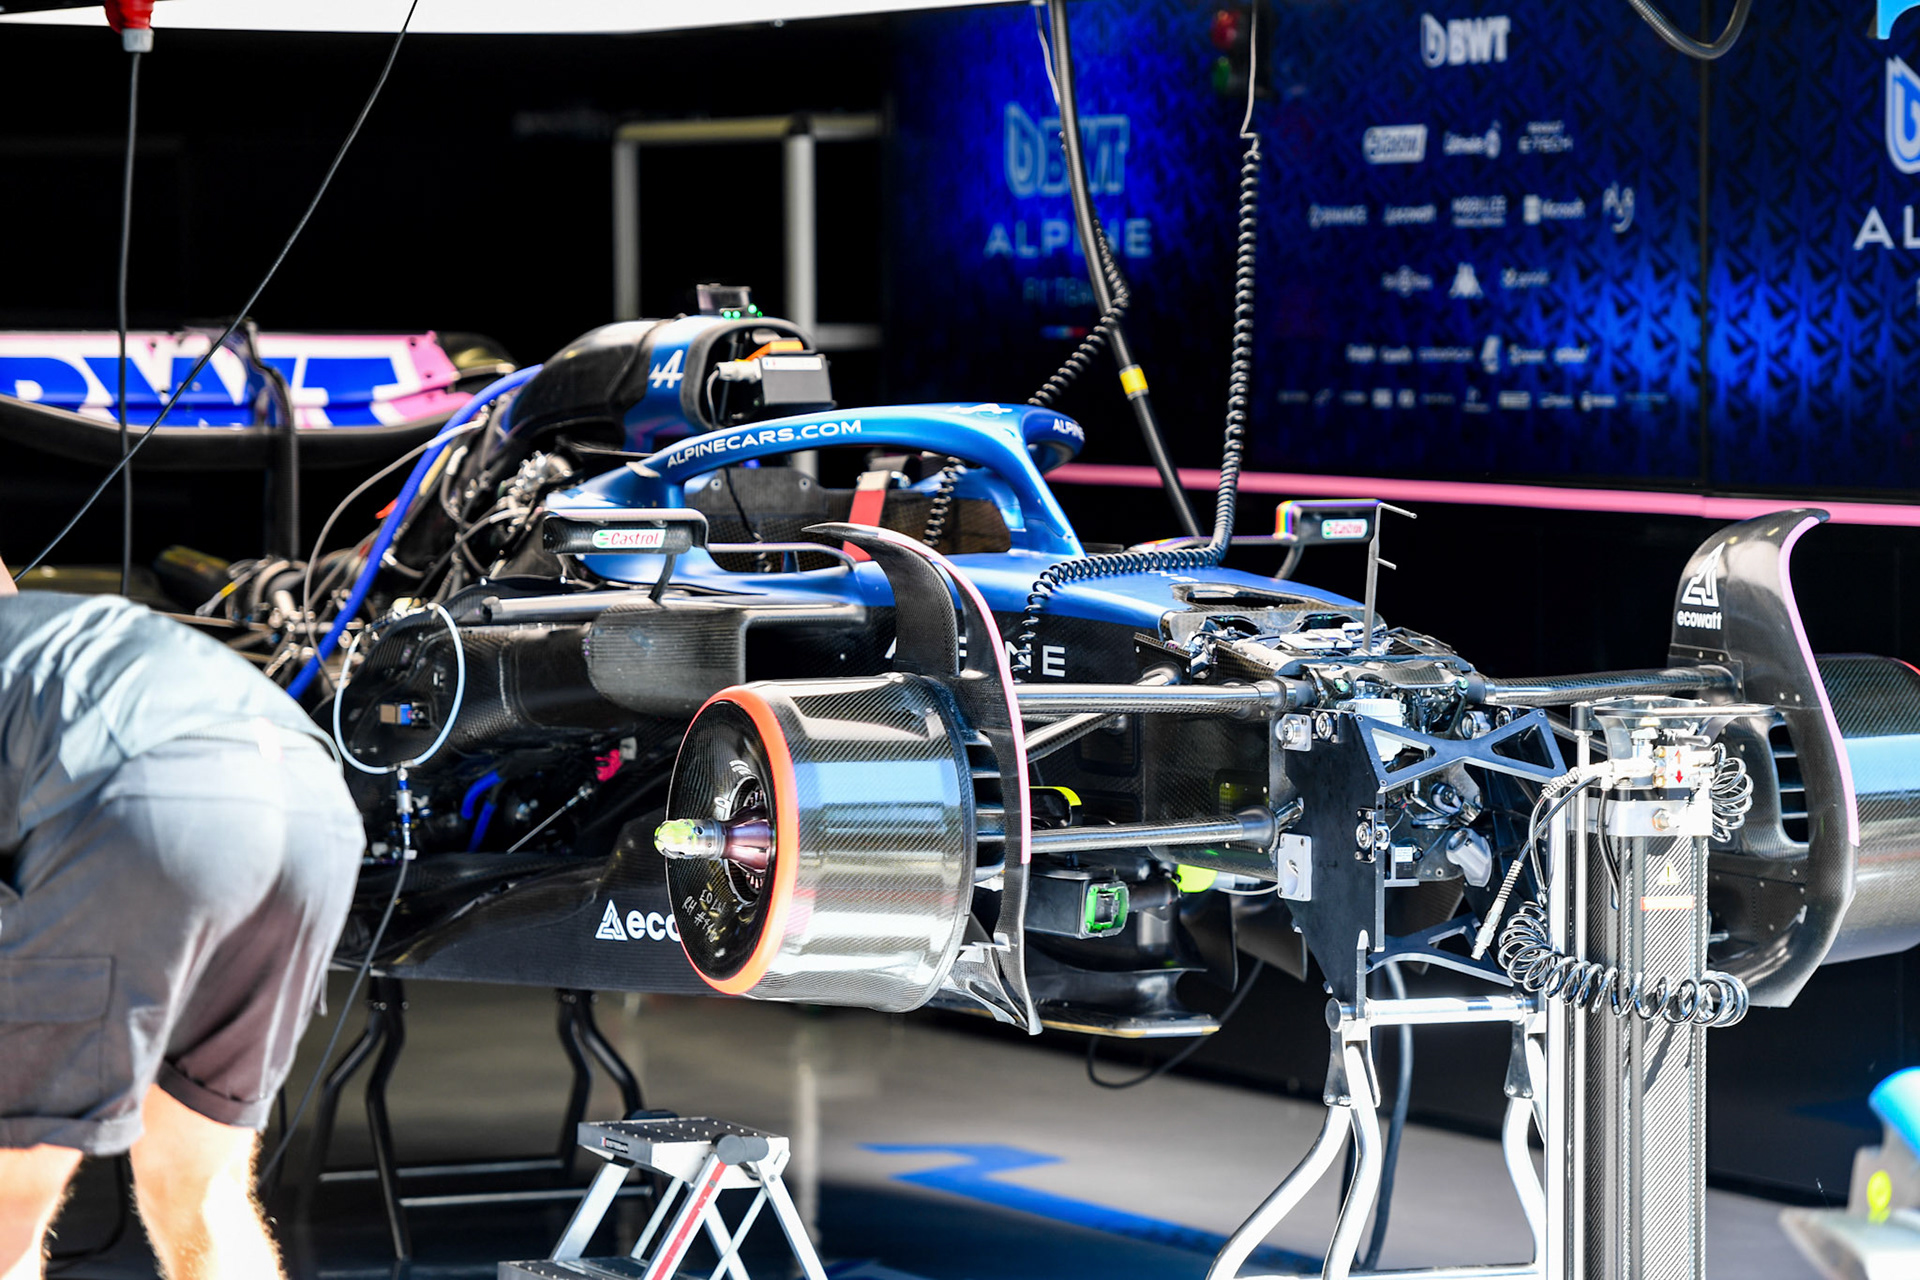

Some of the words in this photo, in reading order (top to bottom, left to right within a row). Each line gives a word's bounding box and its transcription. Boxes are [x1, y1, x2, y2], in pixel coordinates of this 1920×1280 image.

[1446, 16, 1511, 65] BWT
[667, 419, 862, 468] ALPINECARS.COM
[611, 532, 659, 546] Castrol
[1677, 610, 1722, 630] ecowatt
